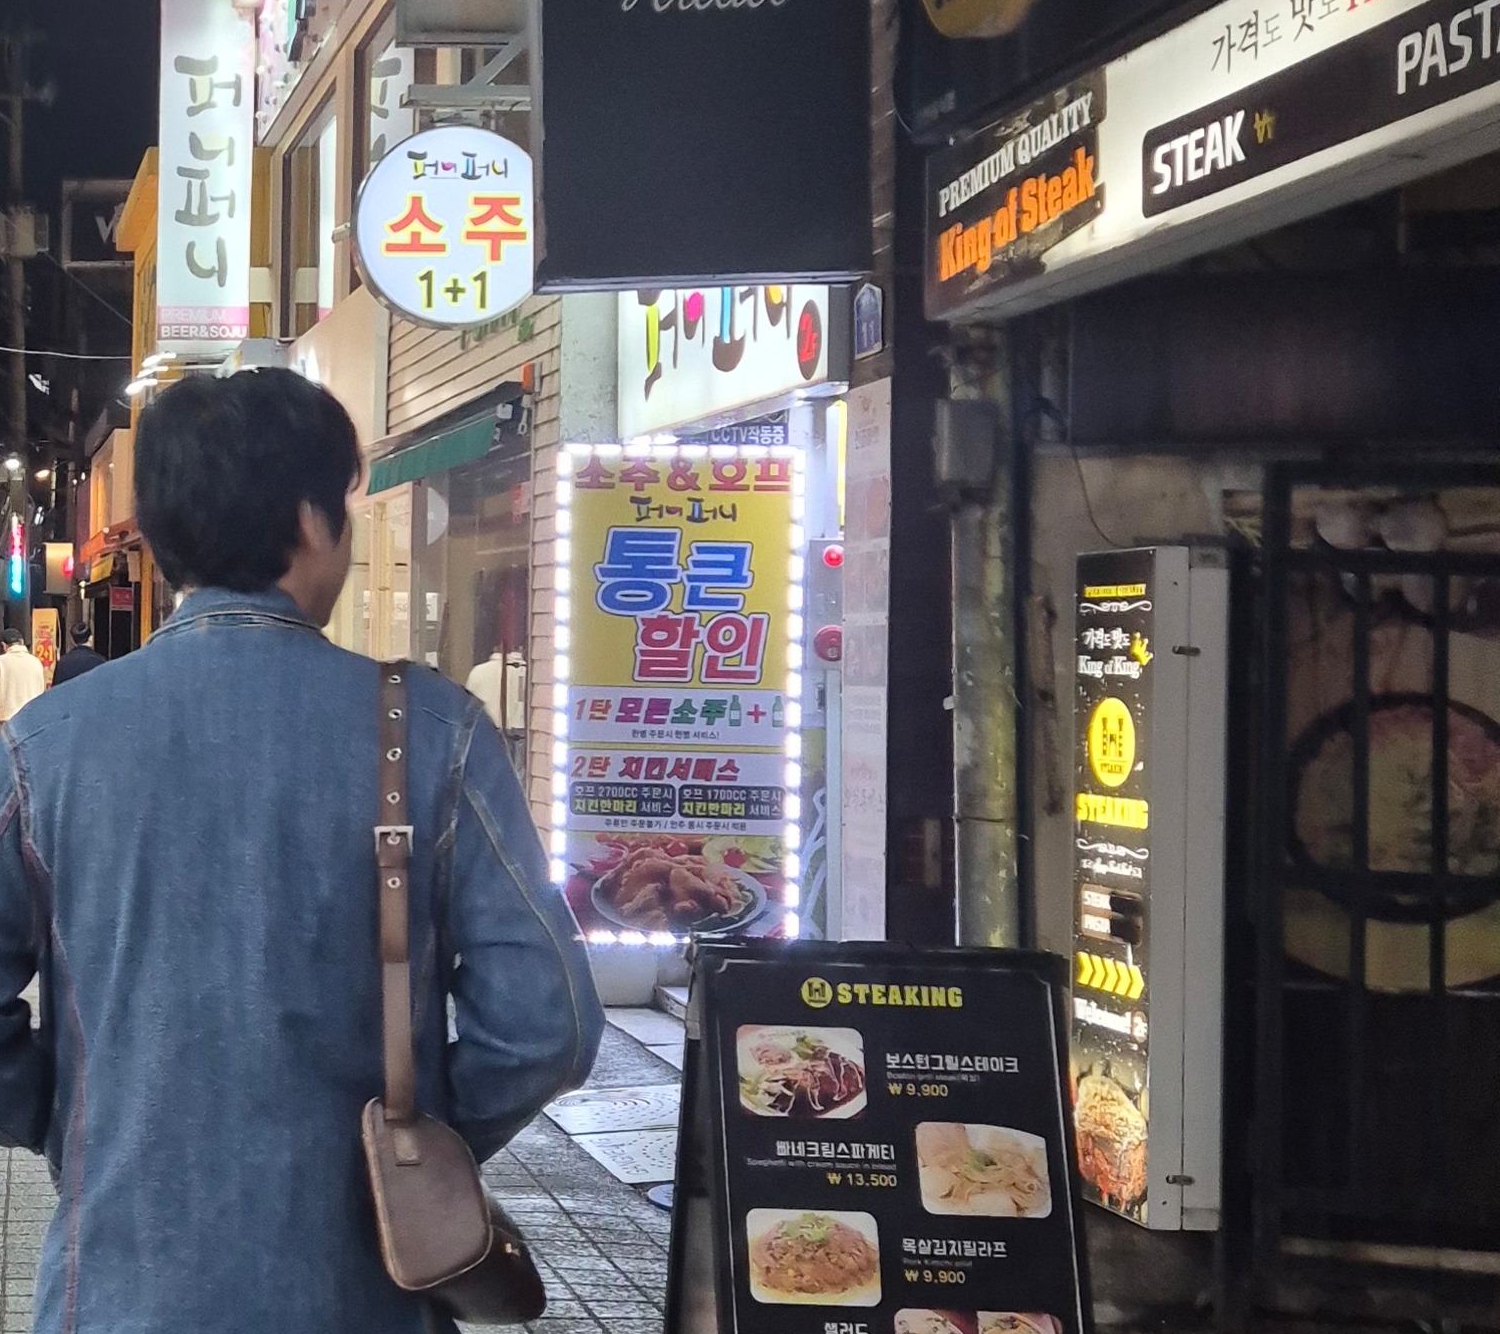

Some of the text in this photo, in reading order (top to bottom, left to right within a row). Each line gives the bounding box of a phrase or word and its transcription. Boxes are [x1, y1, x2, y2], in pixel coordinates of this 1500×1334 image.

[1212, 10, 1282, 73] 가격도
[939, 91, 1092, 217] PREMIUM QUALITY
[1151, 110, 1246, 194] STEAK
[938, 147, 1095, 282] King of Steak
[418, 270, 488, 308] 1+1
[160, 325, 248, 339] BEER&SOJU
[594, 526, 754, 616] 통큰
[633, 610, 770, 684] 할인
[575, 698, 612, 721] 1탄
[571, 756, 611, 778] 2탄
[837, 982, 963, 1007] STEAKING
[886, 1053, 1020, 1073] 보스턴그릴스테이크
[776, 1140, 895, 1160] 빠네크림스파게티
[902, 1238, 1008, 1258] 목살김치필라프
